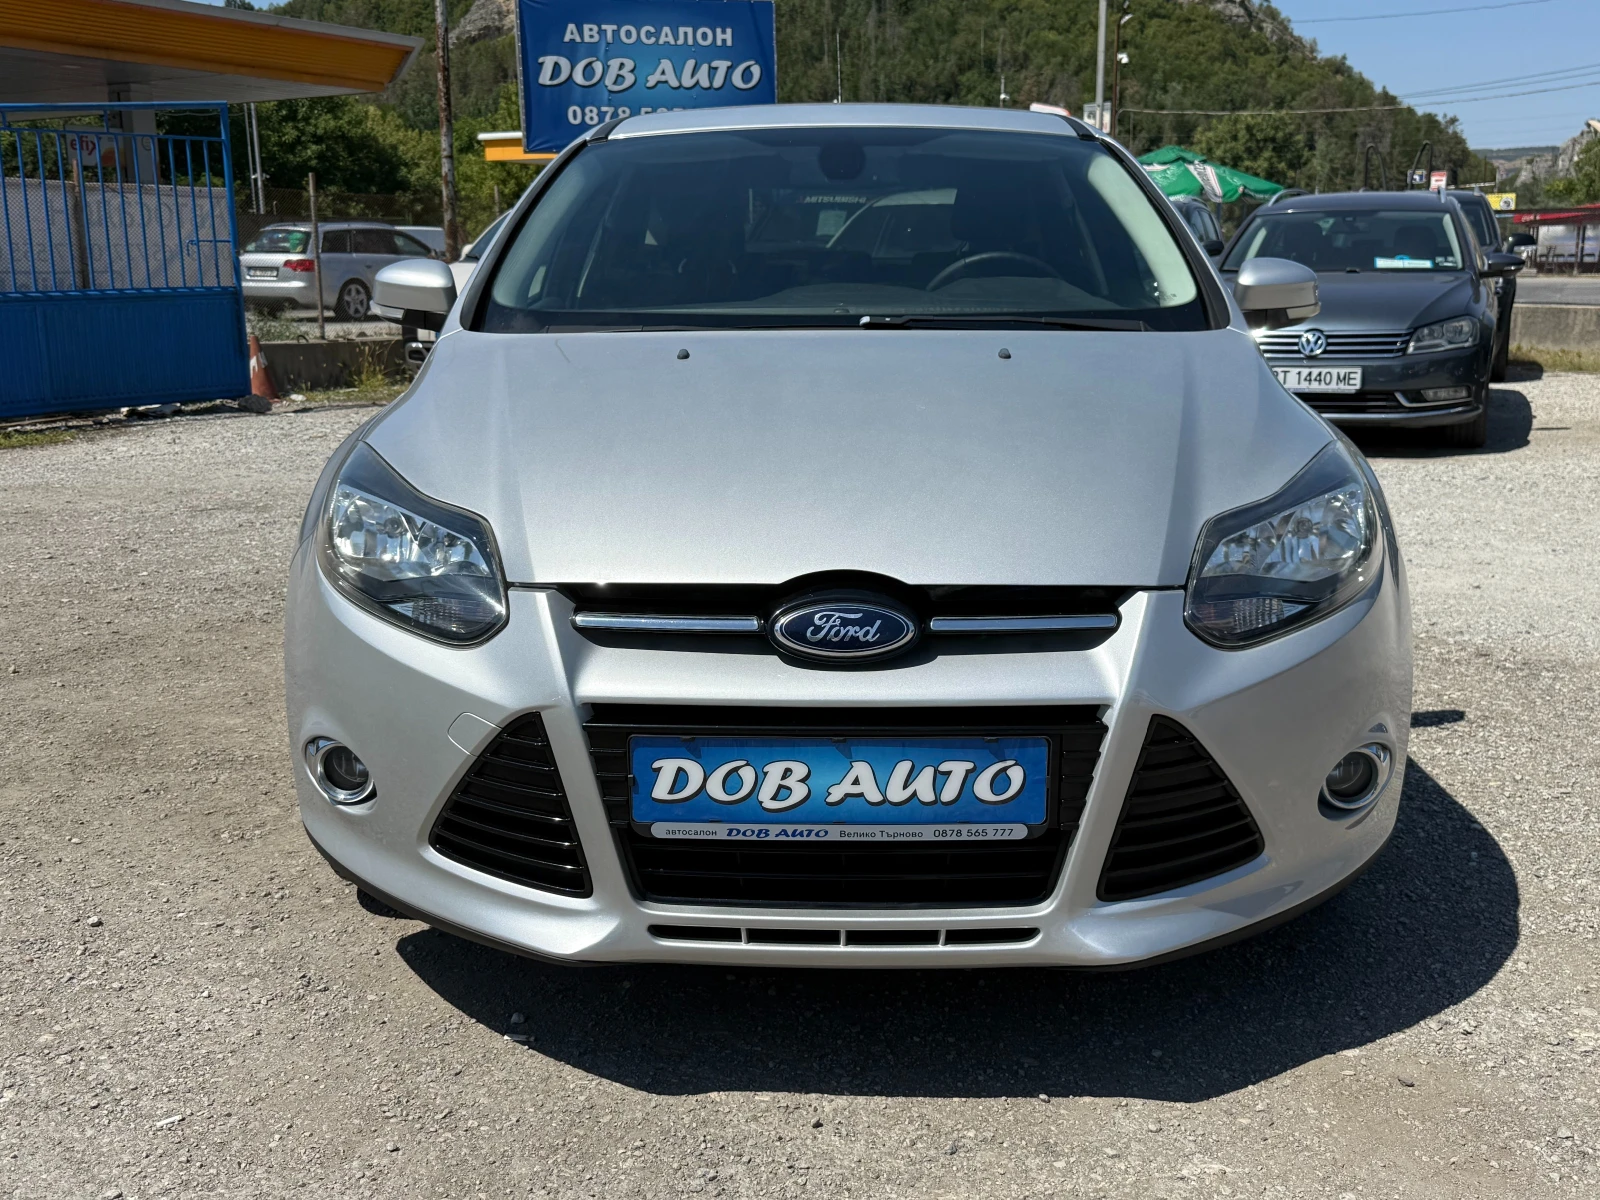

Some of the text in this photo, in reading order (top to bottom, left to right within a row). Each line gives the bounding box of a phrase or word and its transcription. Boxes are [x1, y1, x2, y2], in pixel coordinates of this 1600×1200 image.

[563, 23, 733, 46] АВТОСАЛОН
[537, 55, 762, 92] DOB AUTO
[1296, 370, 1333, 386] 1440
[1336, 371, 1358, 387] ME
[806, 611, 882, 642] Ford
[650, 757, 1026, 811] DOB AUTO
[665, 828, 1014, 839] автосалон DOB AUTO Велико Търново 0878 565 777
